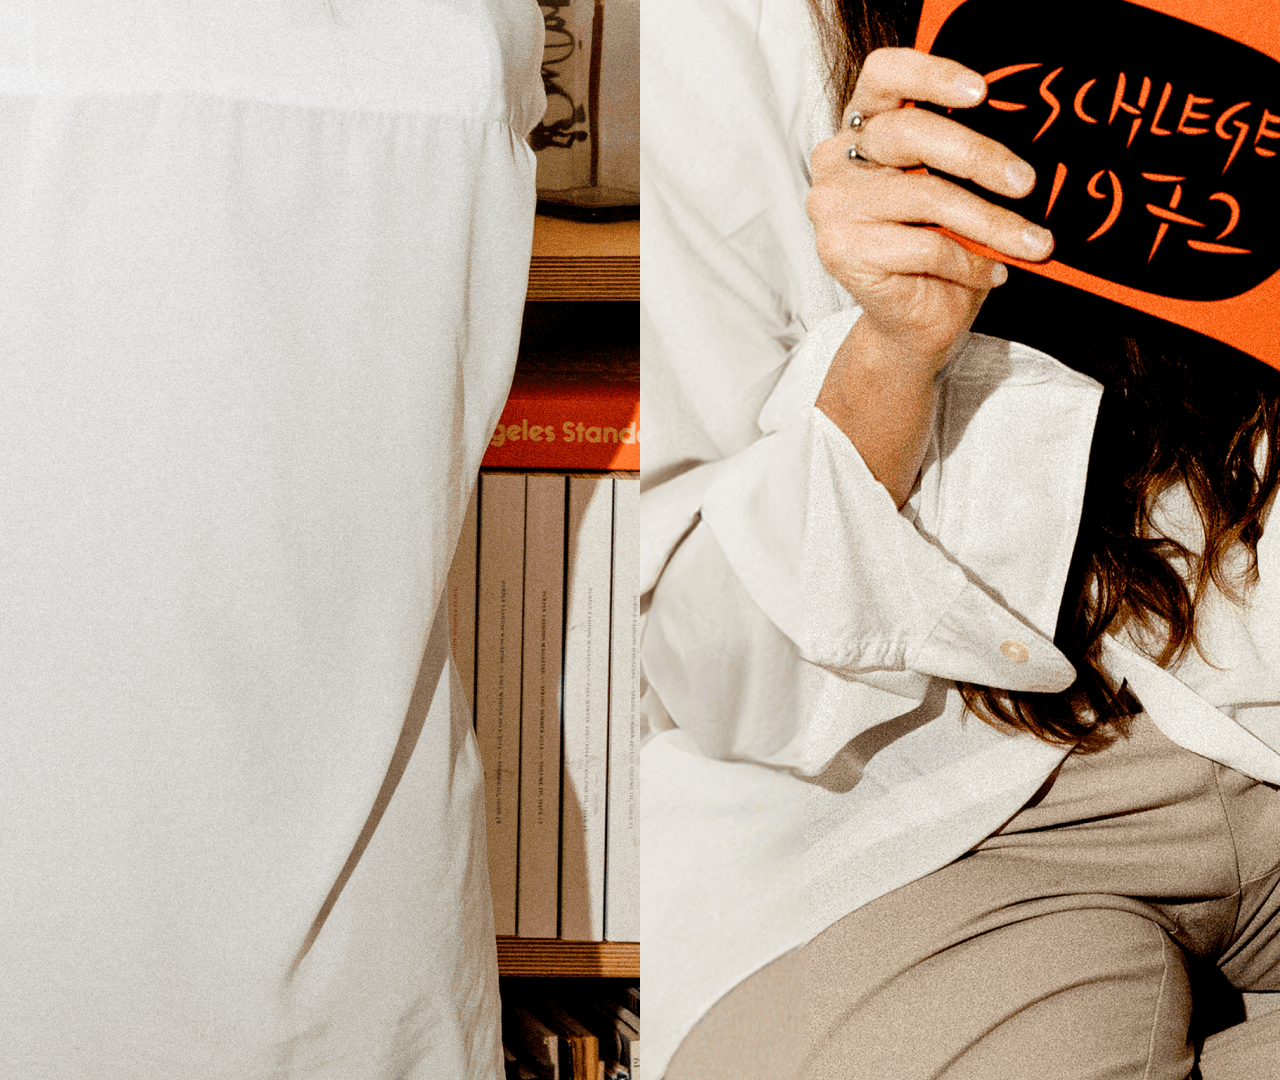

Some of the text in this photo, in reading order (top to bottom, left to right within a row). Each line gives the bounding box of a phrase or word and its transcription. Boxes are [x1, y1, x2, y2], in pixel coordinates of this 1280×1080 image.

[1044, 162, 1252, 264] 1972
[490, 419, 640, 447] geles Stand
